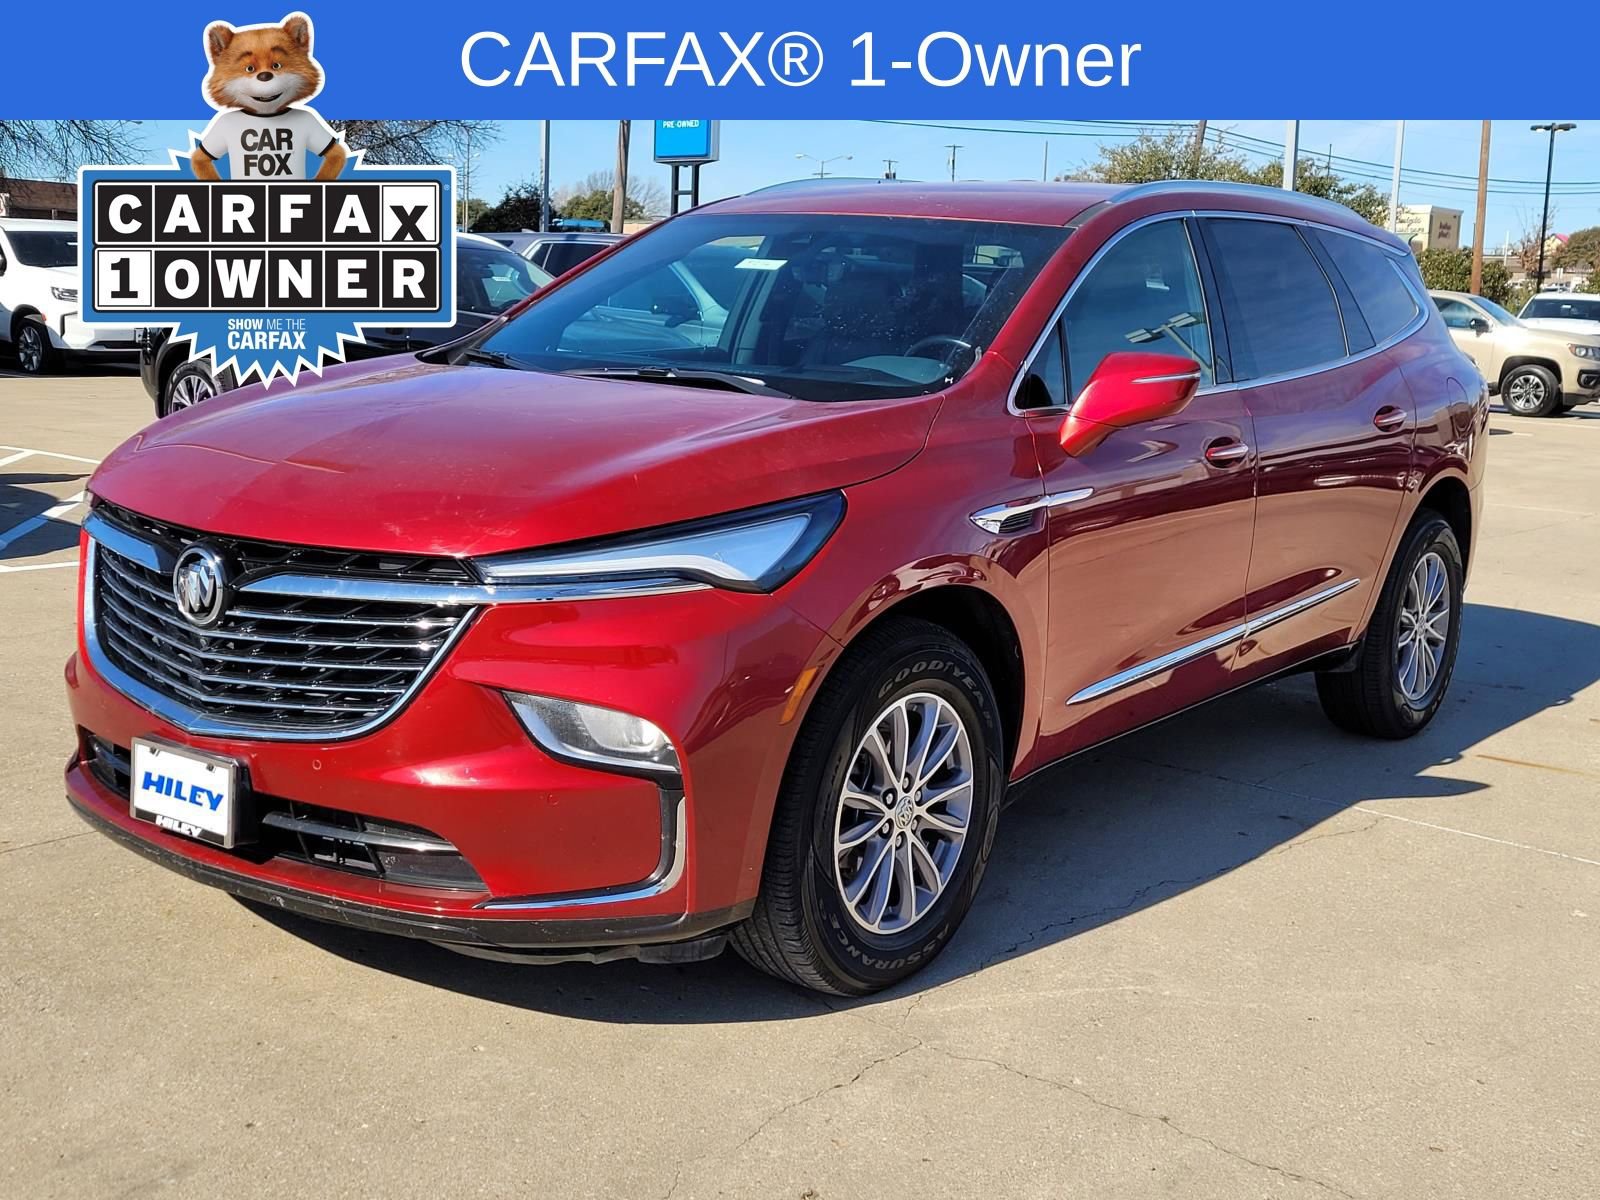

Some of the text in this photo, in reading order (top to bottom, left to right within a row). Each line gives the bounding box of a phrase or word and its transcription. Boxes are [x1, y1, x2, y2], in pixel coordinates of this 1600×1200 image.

[662, 119, 700, 128] PRE-OWNED
[878, 660, 993, 728] GOODYEAR
[142, 771, 224, 811] HILEY
[155, 814, 202, 837] HILEY
[828, 912, 950, 969] ASSURANCE
